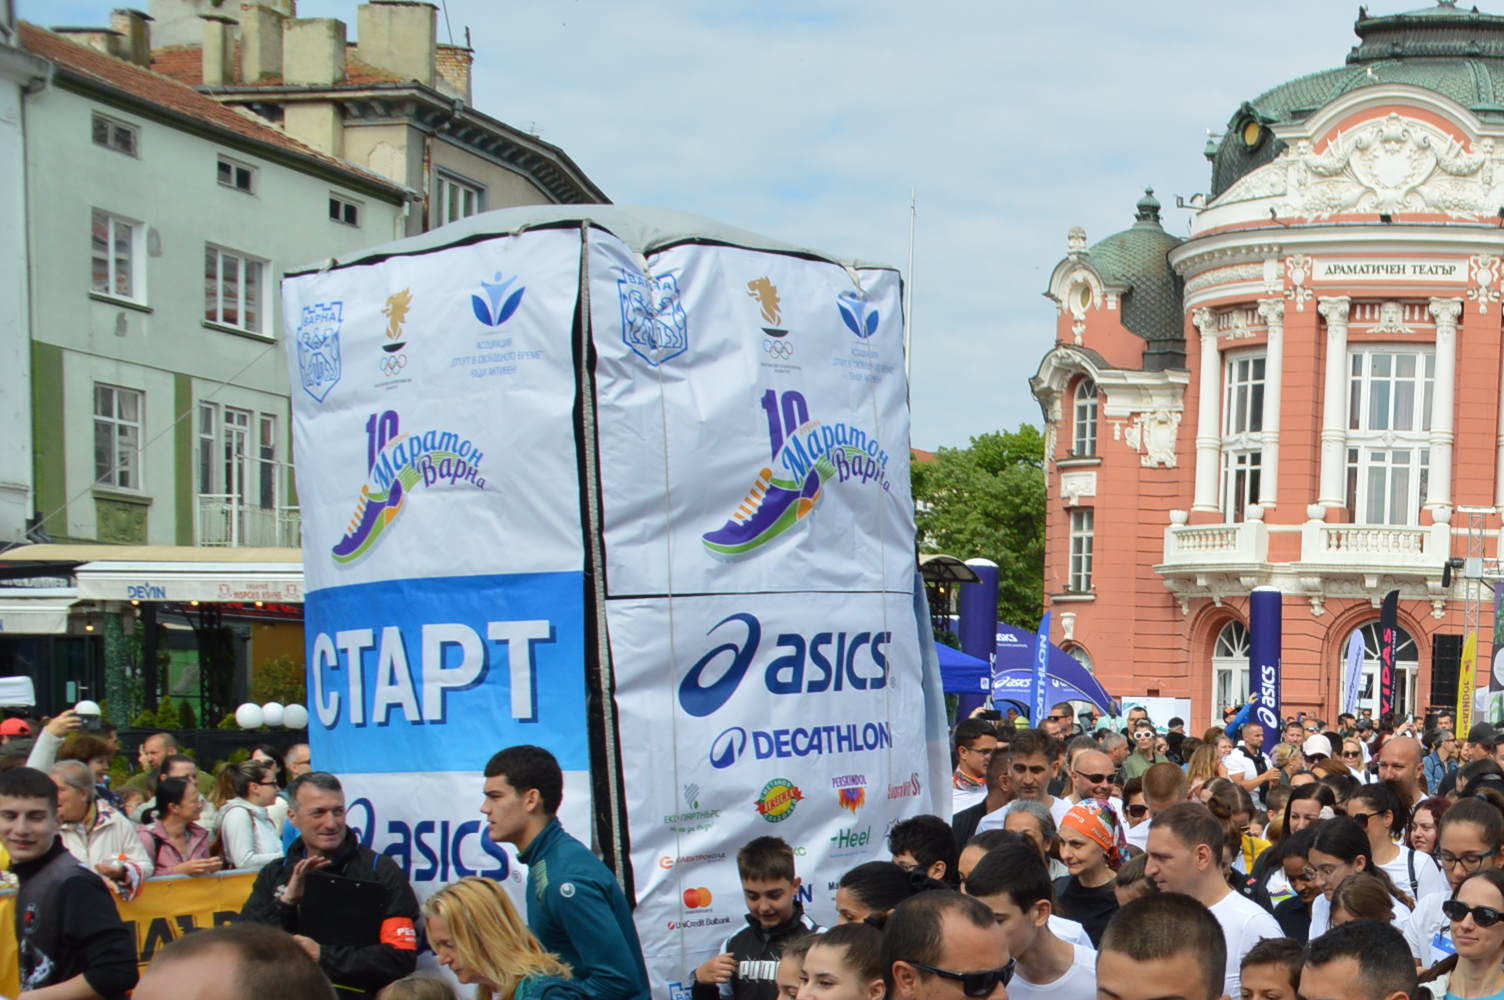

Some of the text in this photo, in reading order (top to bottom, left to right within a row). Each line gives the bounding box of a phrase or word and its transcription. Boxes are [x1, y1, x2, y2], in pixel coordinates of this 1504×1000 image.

[1324, 263, 1457, 276] ДРАМАТИЧЕН ТЕАТЪР
[303, 311, 337, 327] ВАРНА
[366, 410, 400, 479] 10
[761, 388, 810, 463] 10
[374, 430, 484, 491] Маратон
[417, 454, 486, 489] Варна
[781, 423, 889, 486] Маратон
[832, 447, 890, 492] Варна
[127, 584, 166, 599] DEVIN
[312, 619, 554, 729] СТАРТ
[764, 630, 893, 695] asics
[1034, 634, 1048, 727] CATHLON
[1262, 665, 1276, 708] asics
[752, 721, 893, 760] DECATHLON
[832, 774, 867, 788] PERSKINDOL
[383, 820, 510, 882] asics
[675, 917, 730, 931] UniCredit Bulbank
[739, 959, 780, 981] PUM
